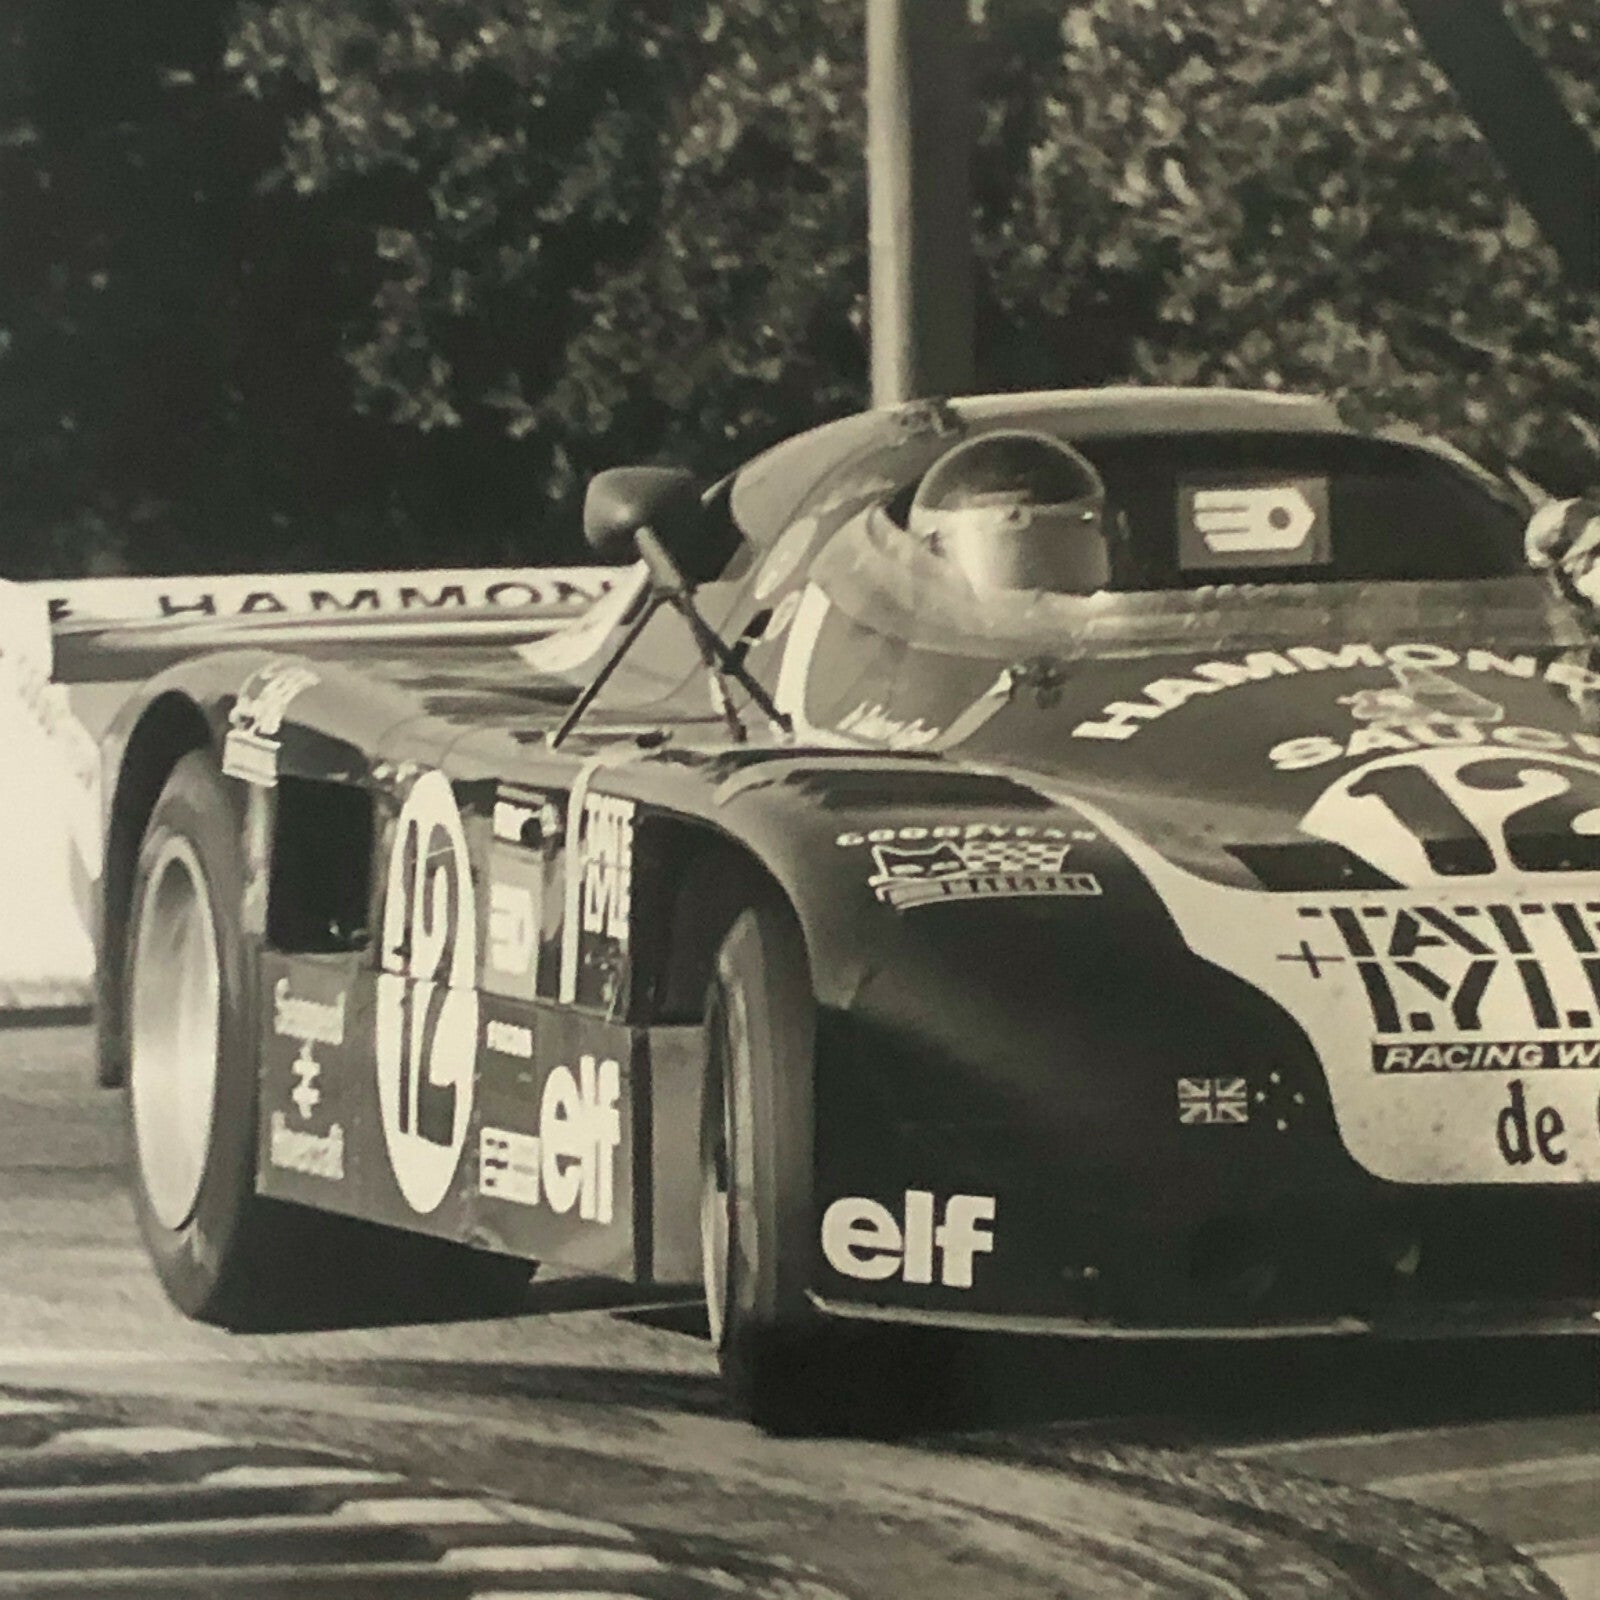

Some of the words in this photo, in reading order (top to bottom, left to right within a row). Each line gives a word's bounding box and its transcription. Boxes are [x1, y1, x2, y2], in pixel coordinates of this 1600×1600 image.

[1346, 757, 1600, 876] 12
[1382, 1043, 1544, 1070] RACING
[1496, 1079, 1568, 1165] de
[821, 1189, 996, 1288] elf
